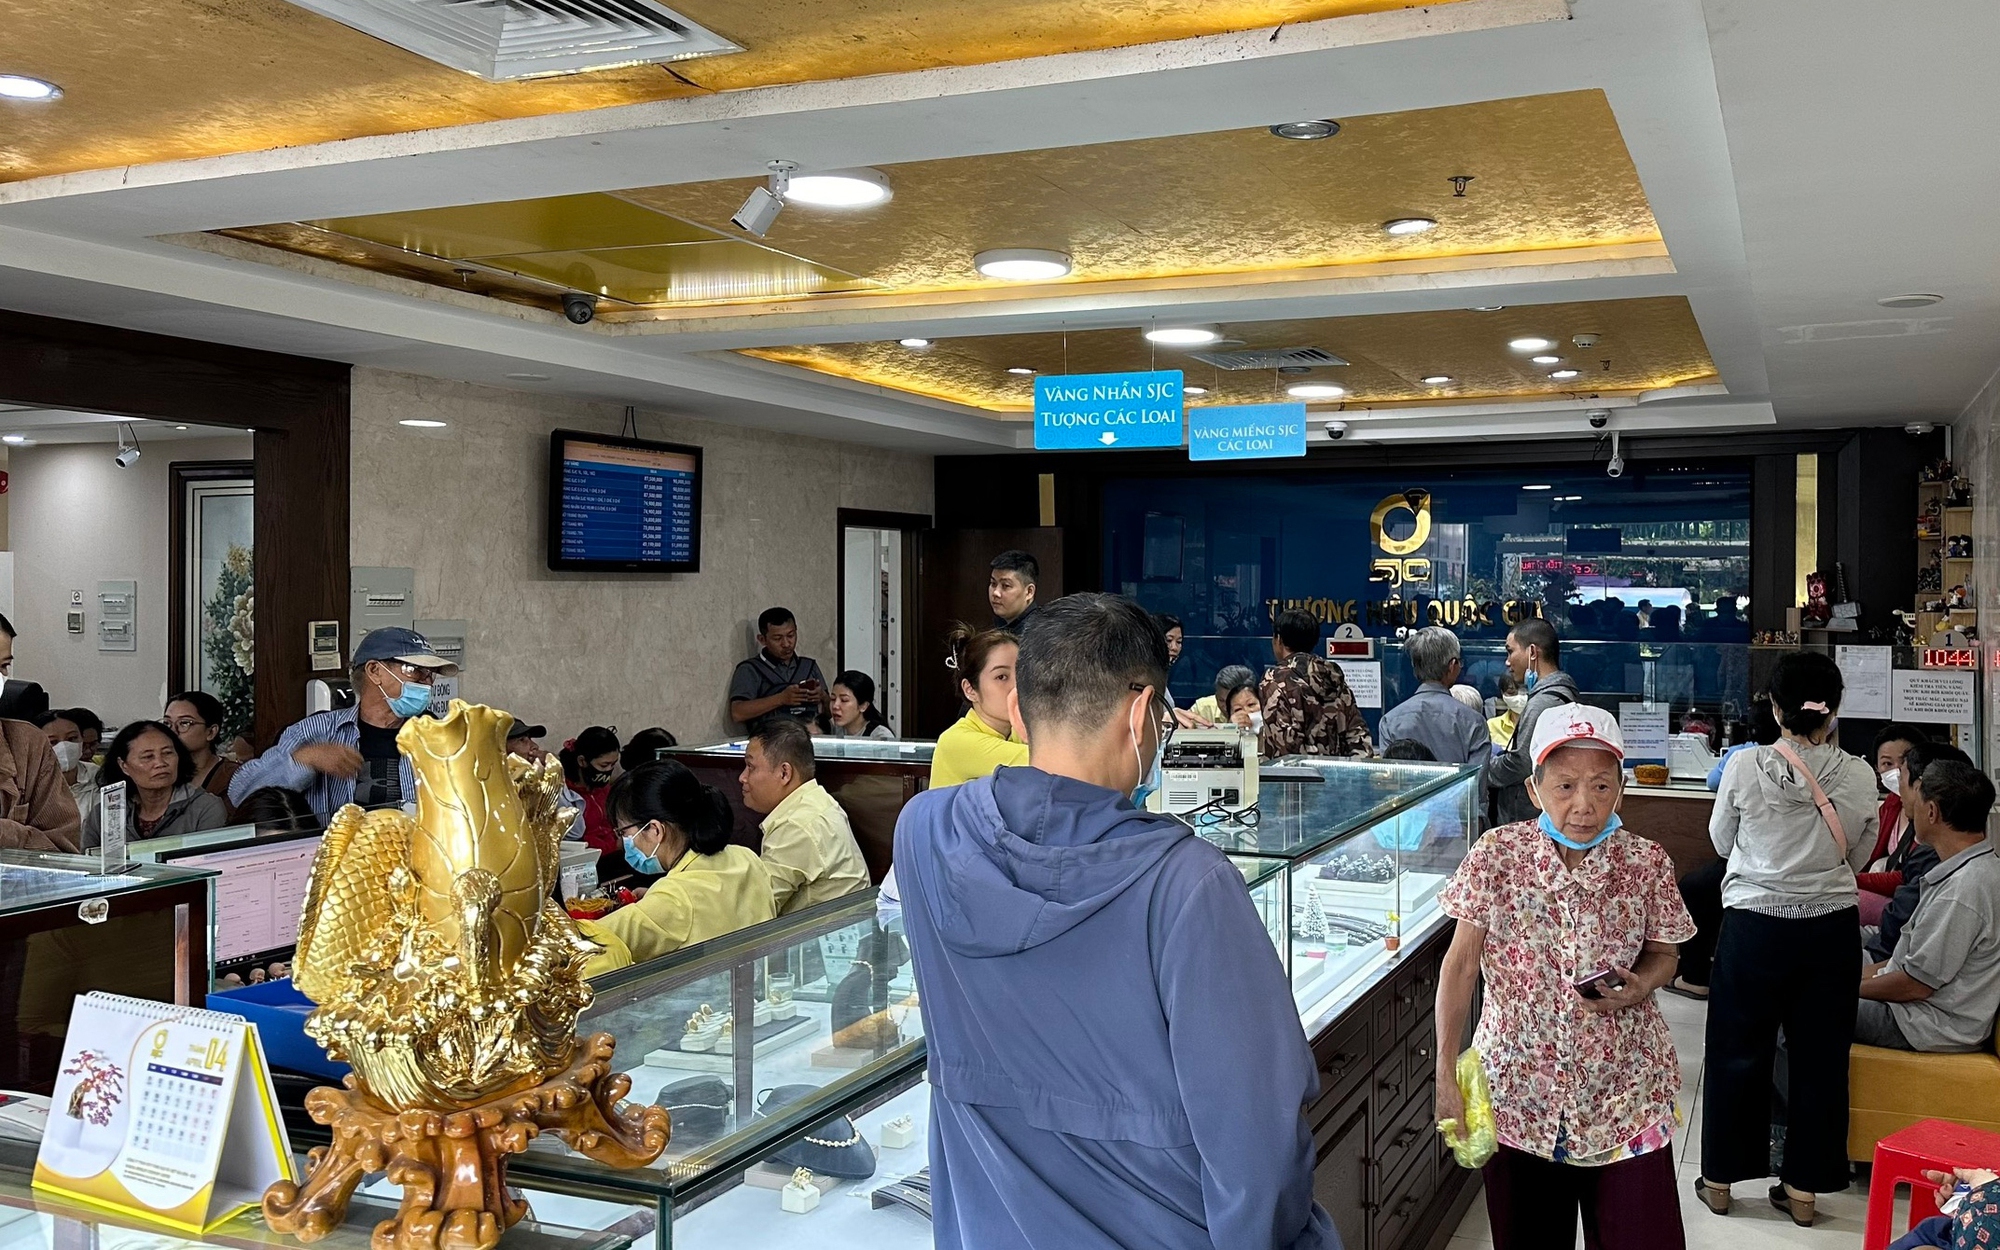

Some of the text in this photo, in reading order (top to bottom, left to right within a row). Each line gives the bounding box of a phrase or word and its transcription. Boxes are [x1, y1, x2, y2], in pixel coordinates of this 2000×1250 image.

[1044, 380, 1174, 402] VÀNG NHẪN SJC
[1040, 408, 1176, 429] TƯỢNG CÁC LOẠI
[1193, 423, 1299, 439] VÀNG MIẾNG SJC
[1217, 439, 1273, 452] CÁC LOẠI
[1345, 627, 1353, 638] 2
[1945, 633, 1953, 647] 1
[1924, 649, 1975, 667] 1044
